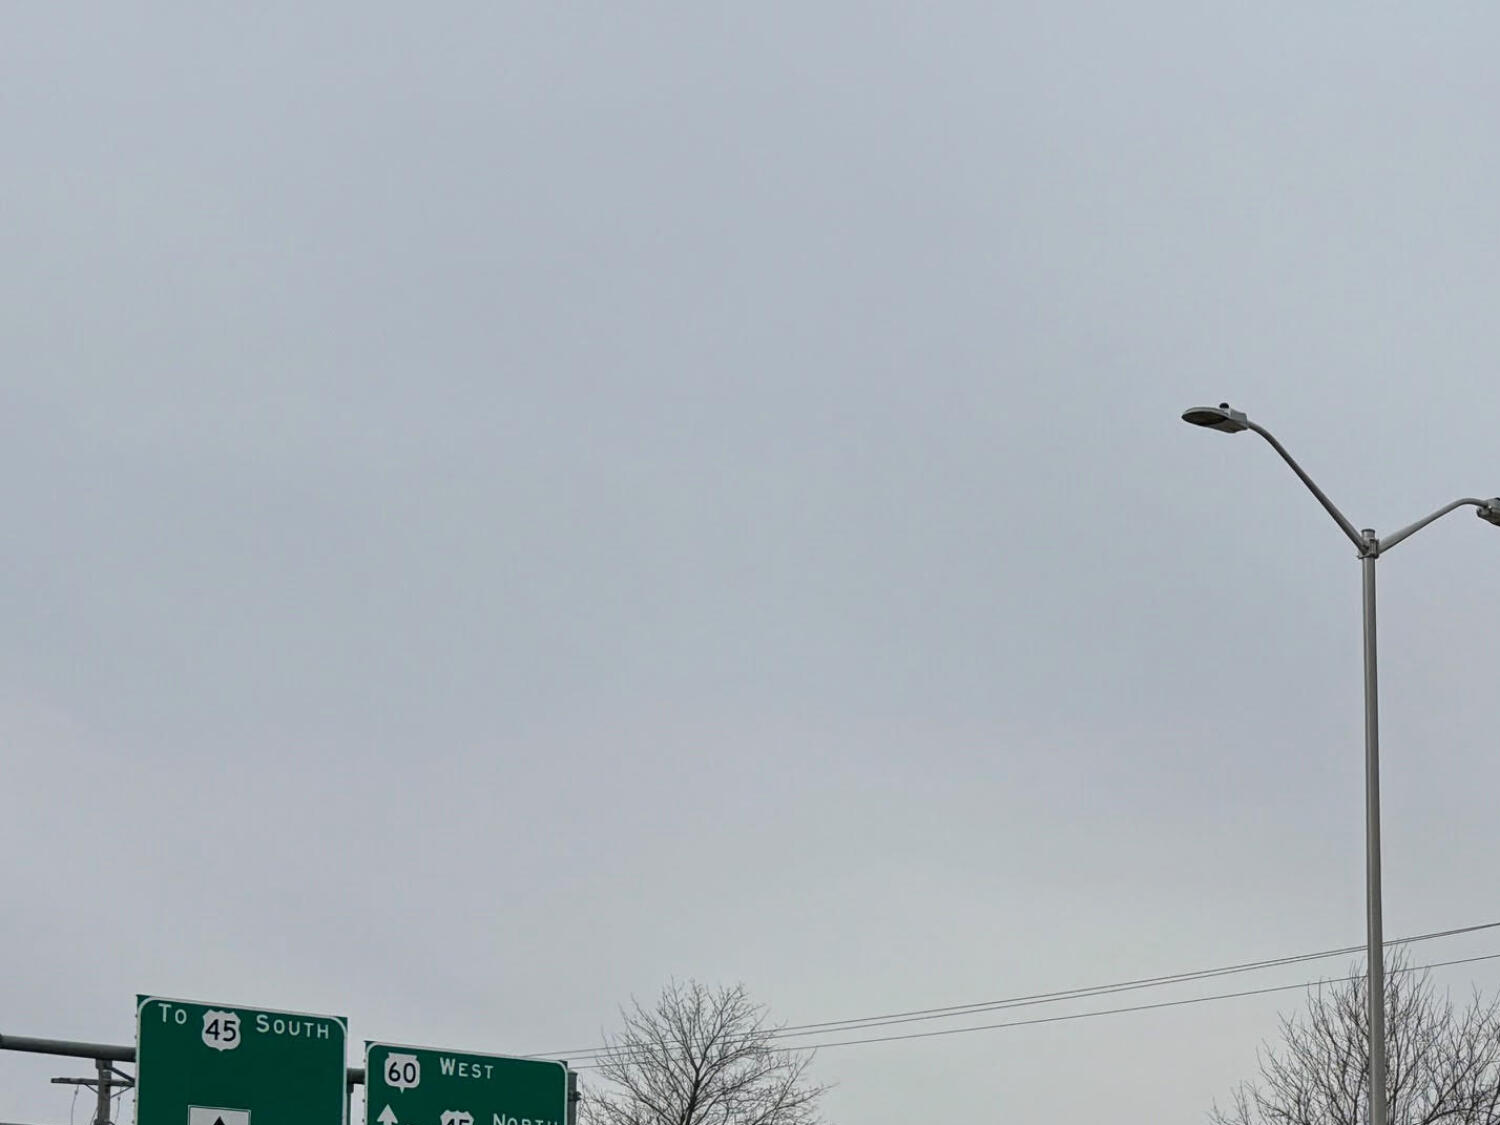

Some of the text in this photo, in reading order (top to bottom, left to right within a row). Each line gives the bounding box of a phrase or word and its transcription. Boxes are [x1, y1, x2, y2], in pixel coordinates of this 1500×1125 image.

[205, 1019, 237, 1042] 45
[256, 1014, 329, 1039] SOUTH
[388, 1057, 494, 1083] 60 WEST
